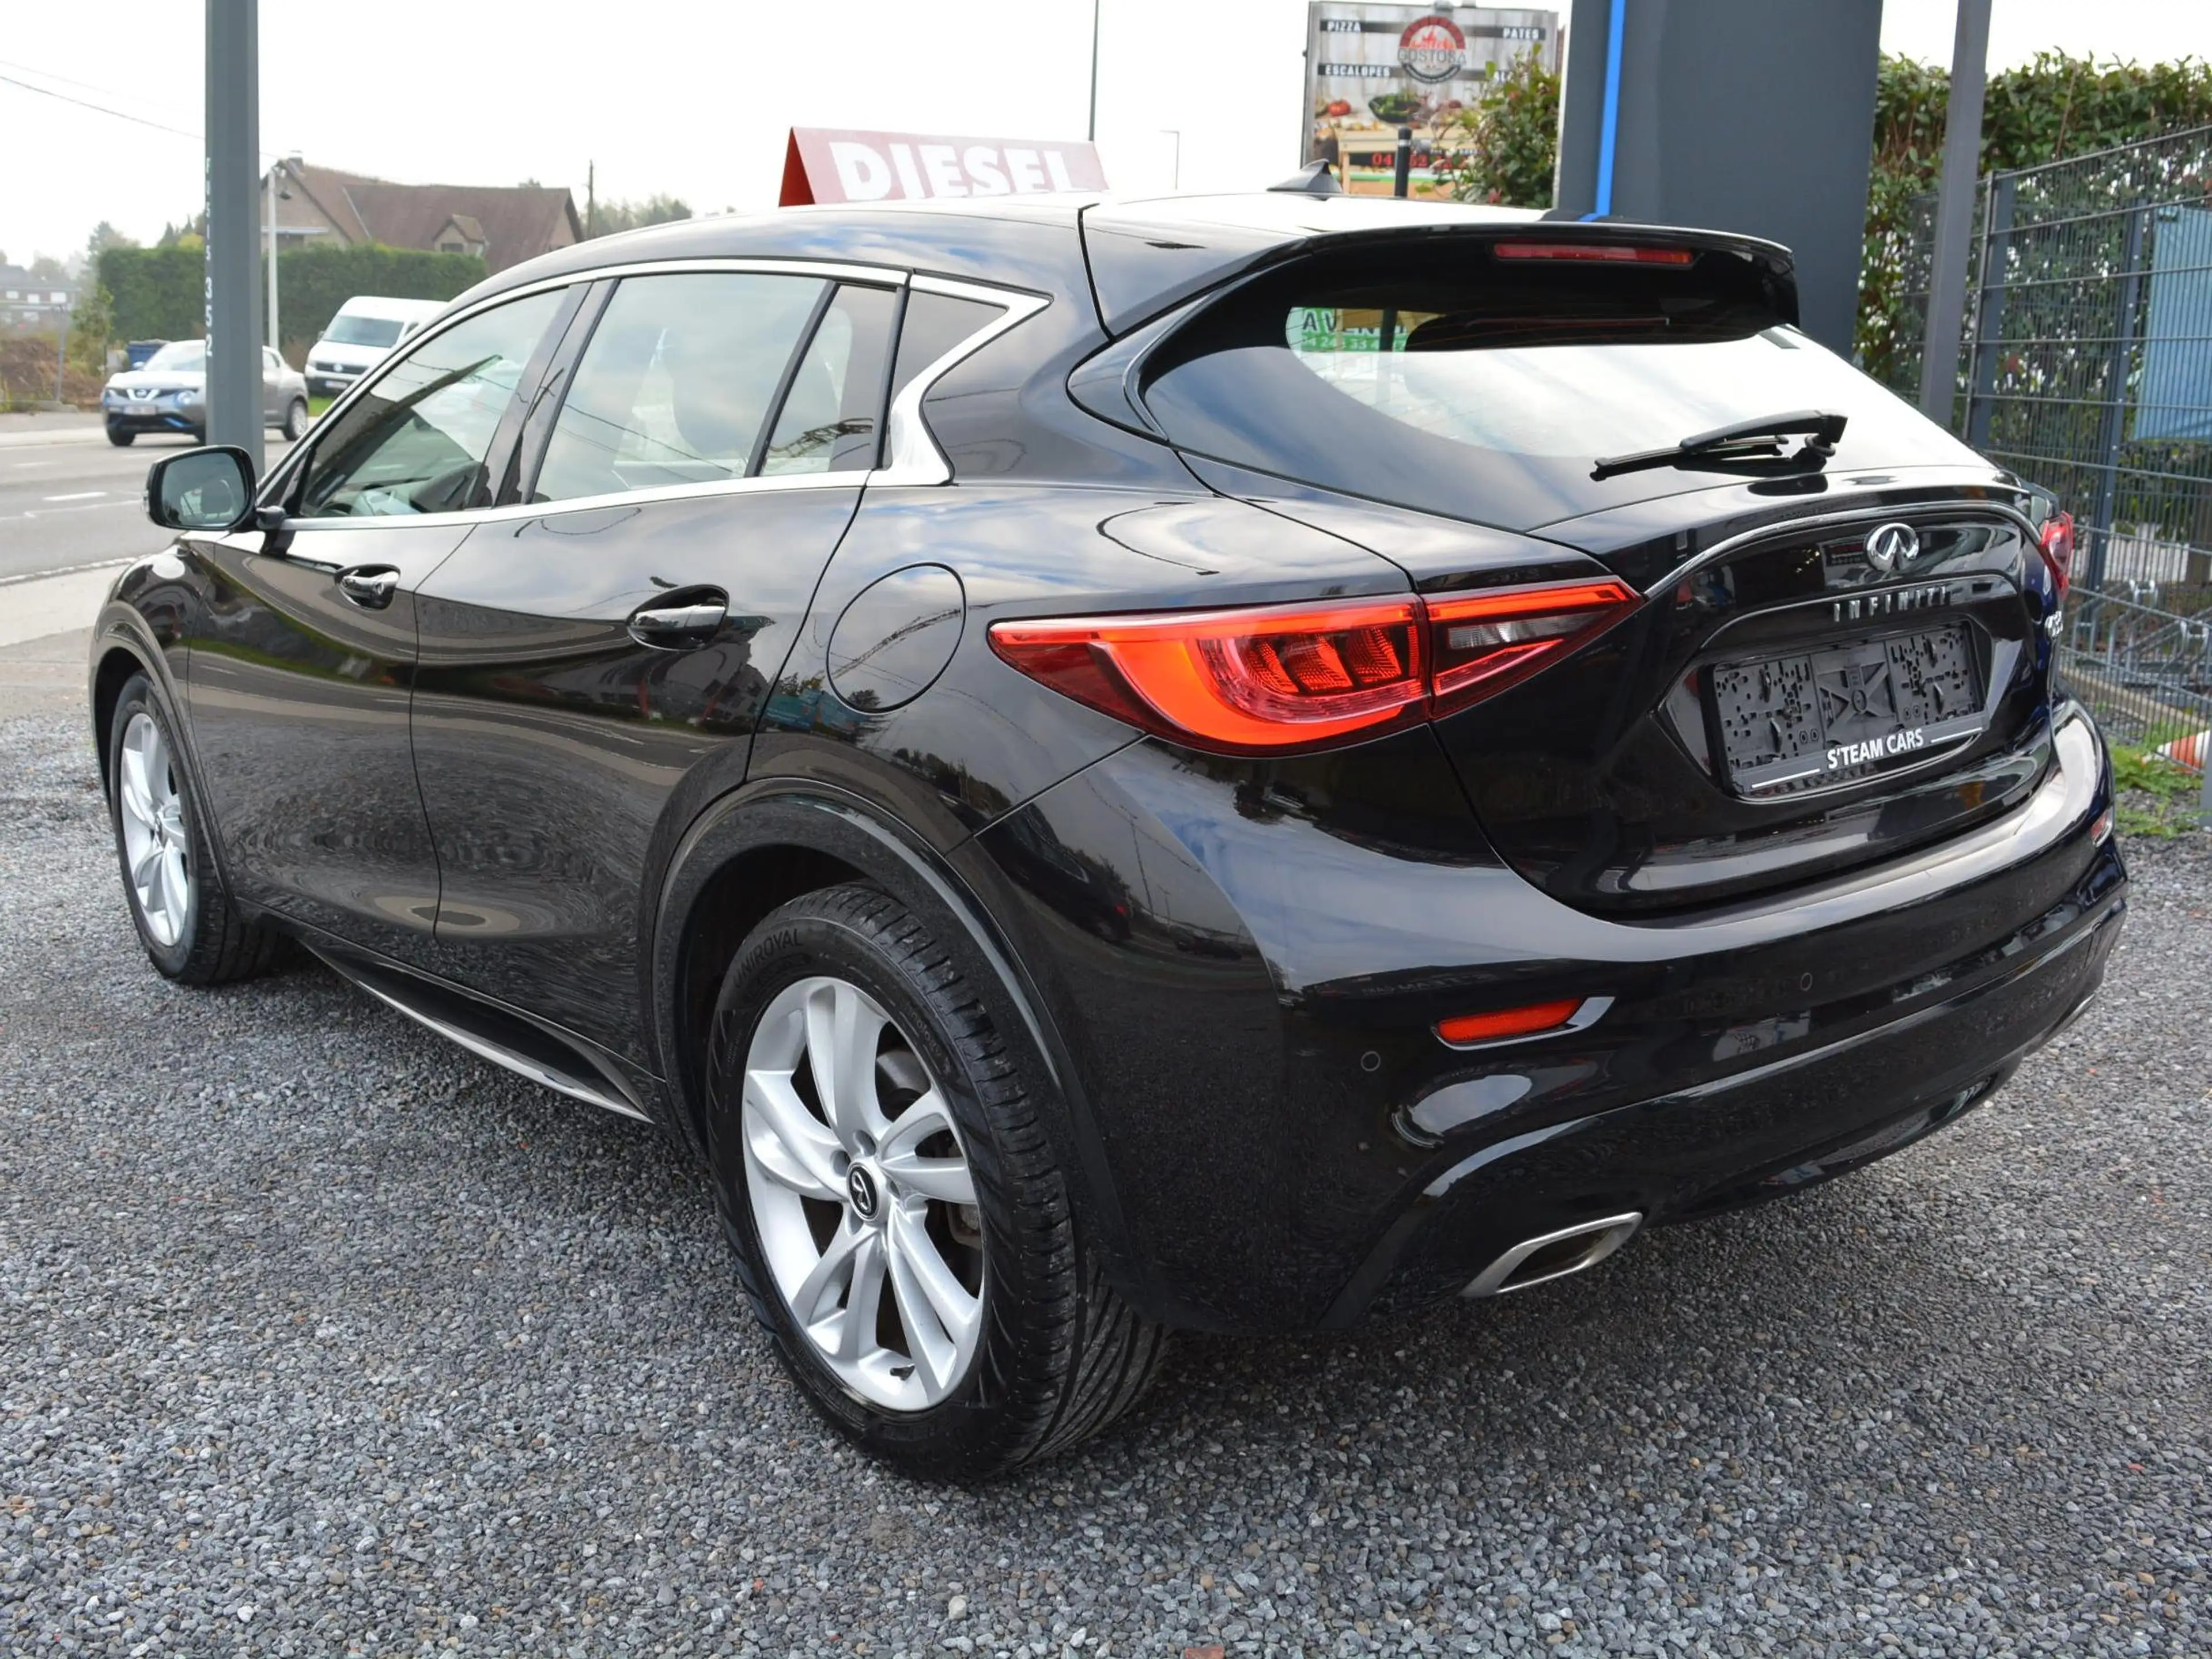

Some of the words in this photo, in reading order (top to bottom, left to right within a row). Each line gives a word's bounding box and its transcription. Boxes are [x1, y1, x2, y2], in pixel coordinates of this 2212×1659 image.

[1327, 21, 1361, 32] PIZZA
[1503, 28, 1539, 40] PATES
[1325, 65, 1390, 78] ESCALOPES
[829, 141, 1089, 200] DIESEL
[1833, 585, 1946, 623] INFINITI
[1827, 738, 1884, 770] S'TEAM
[1886, 728, 1924, 753] CARS
